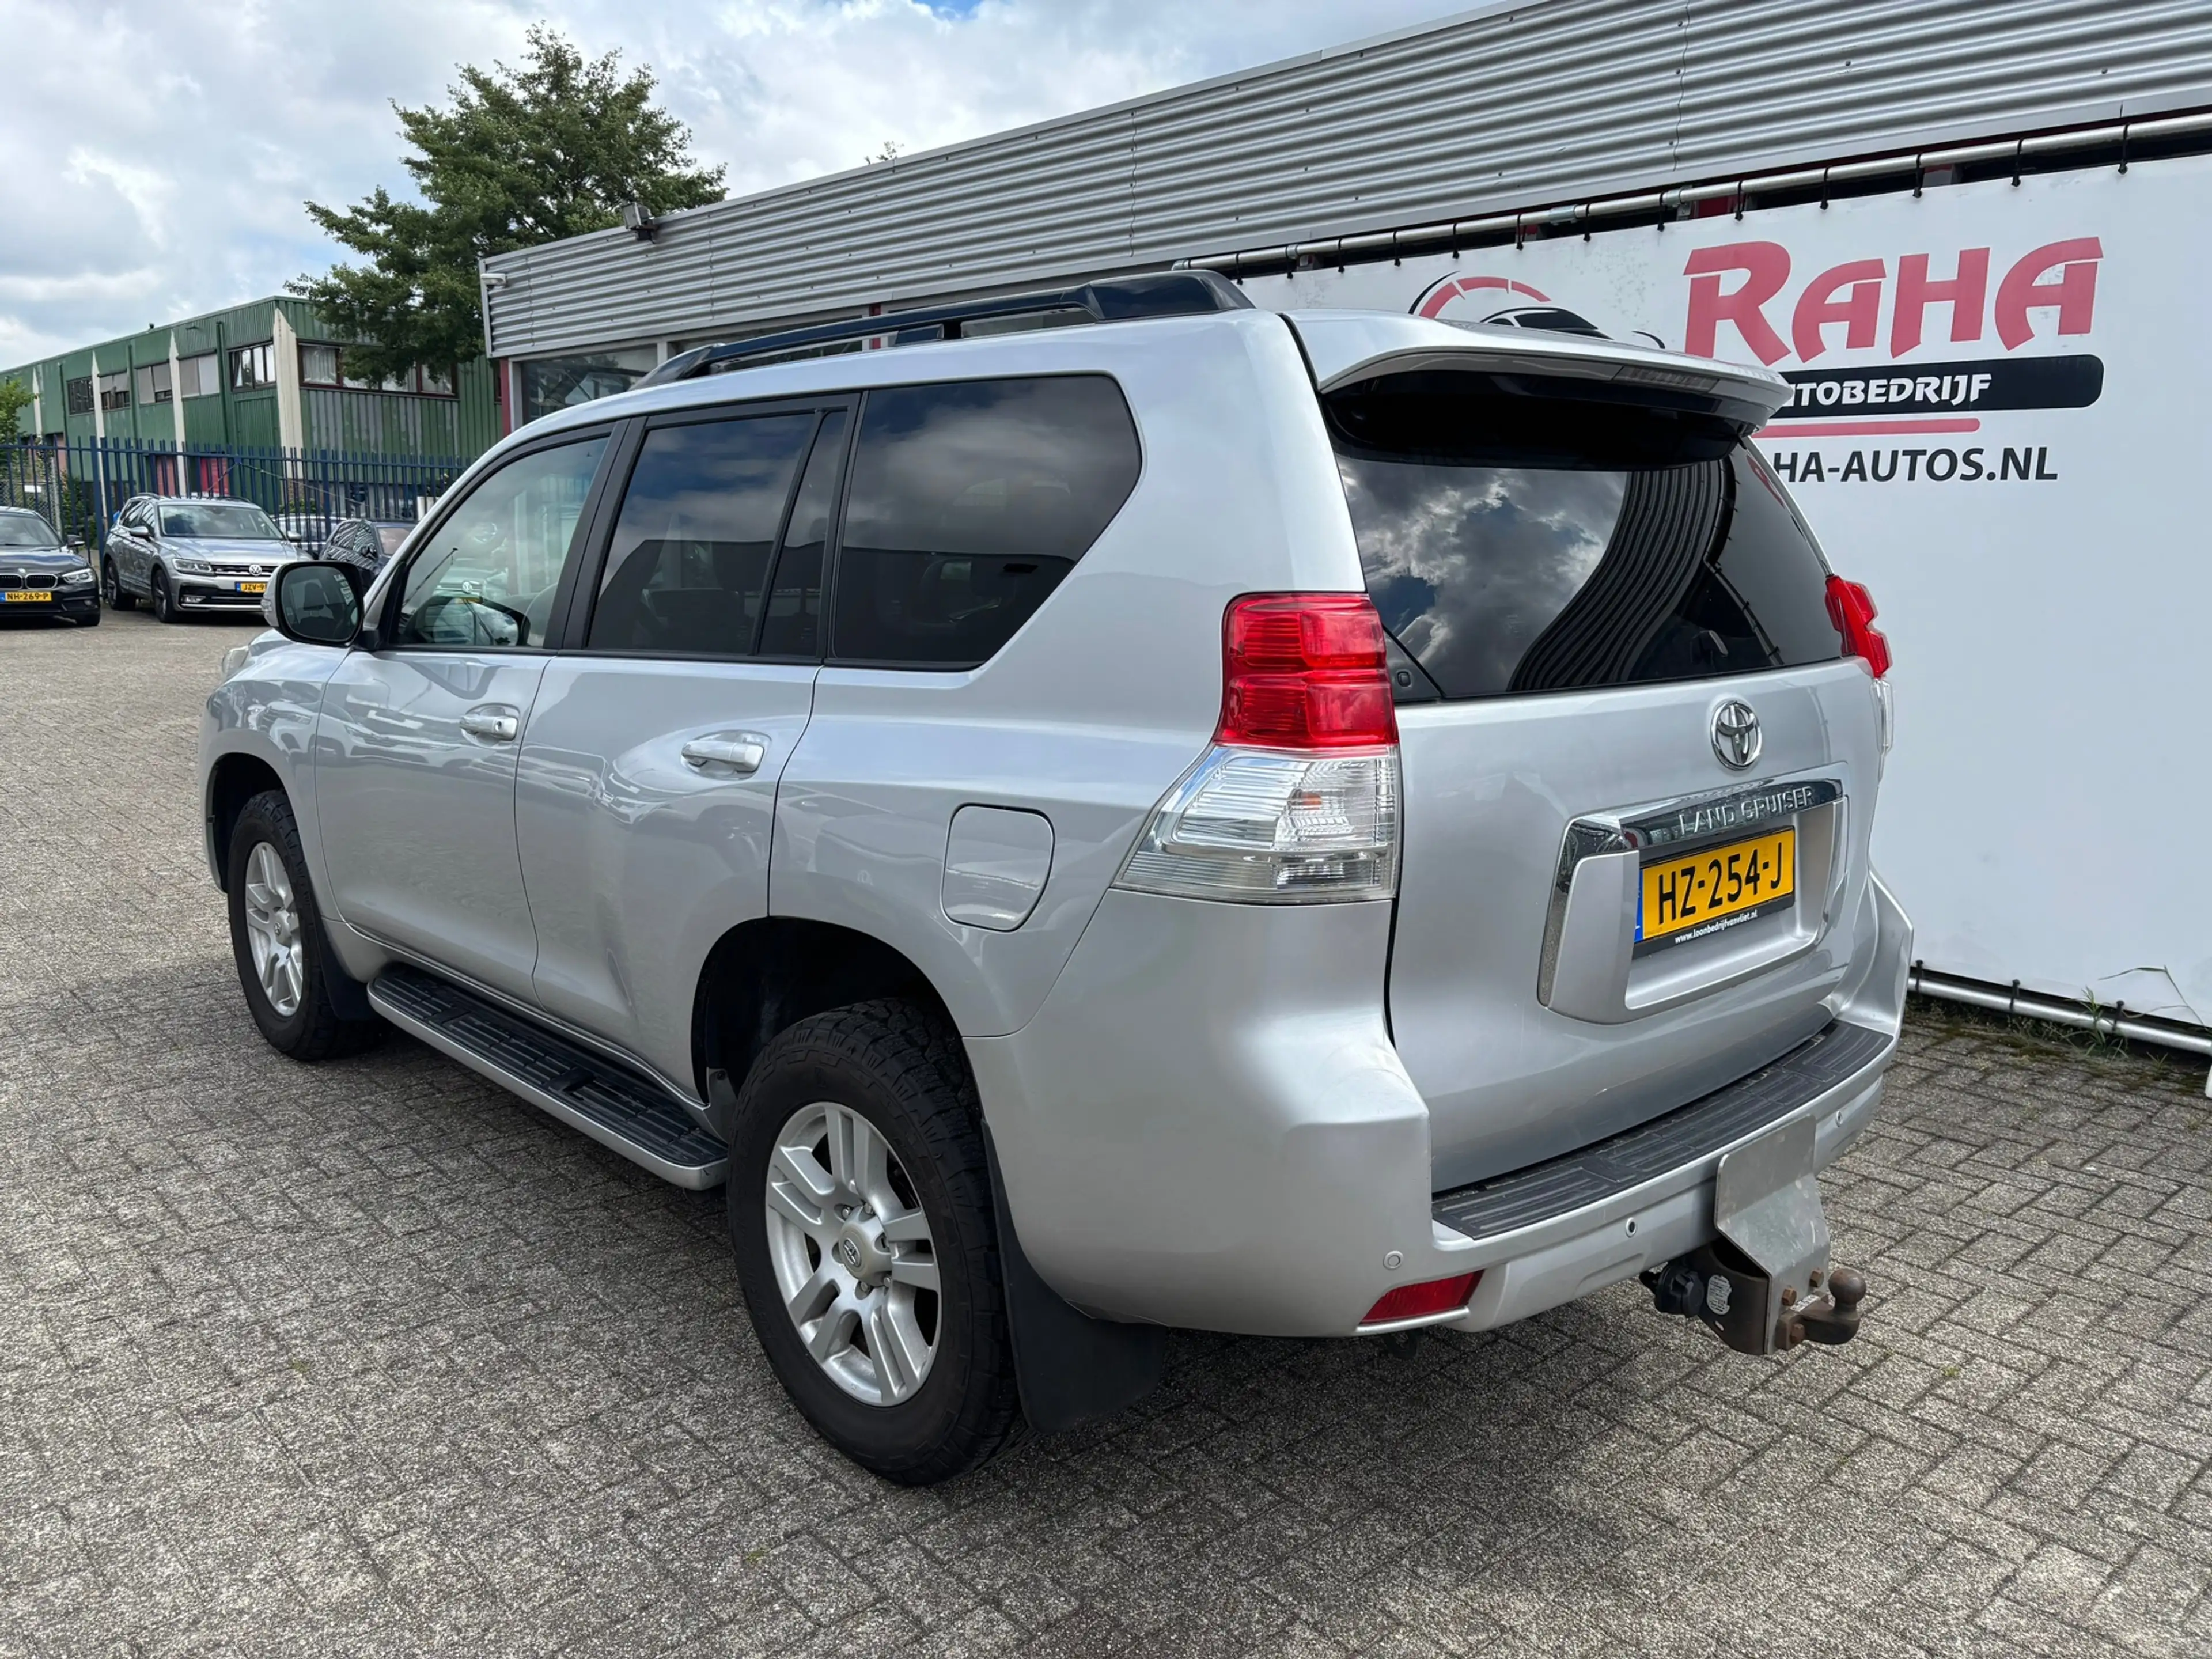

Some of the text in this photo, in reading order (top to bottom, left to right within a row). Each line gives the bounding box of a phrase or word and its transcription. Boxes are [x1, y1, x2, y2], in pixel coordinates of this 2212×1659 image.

[1683, 236, 2104, 366] RAHA
[1772, 446, 2059, 483] HA-AUTOS.NL
[1679, 785, 1815, 836] LAND CRUISER
[1658, 842, 1782, 925] HZ-254-J
[1675, 909, 1758, 944] www.loonbedrijfvanvliet.nl
